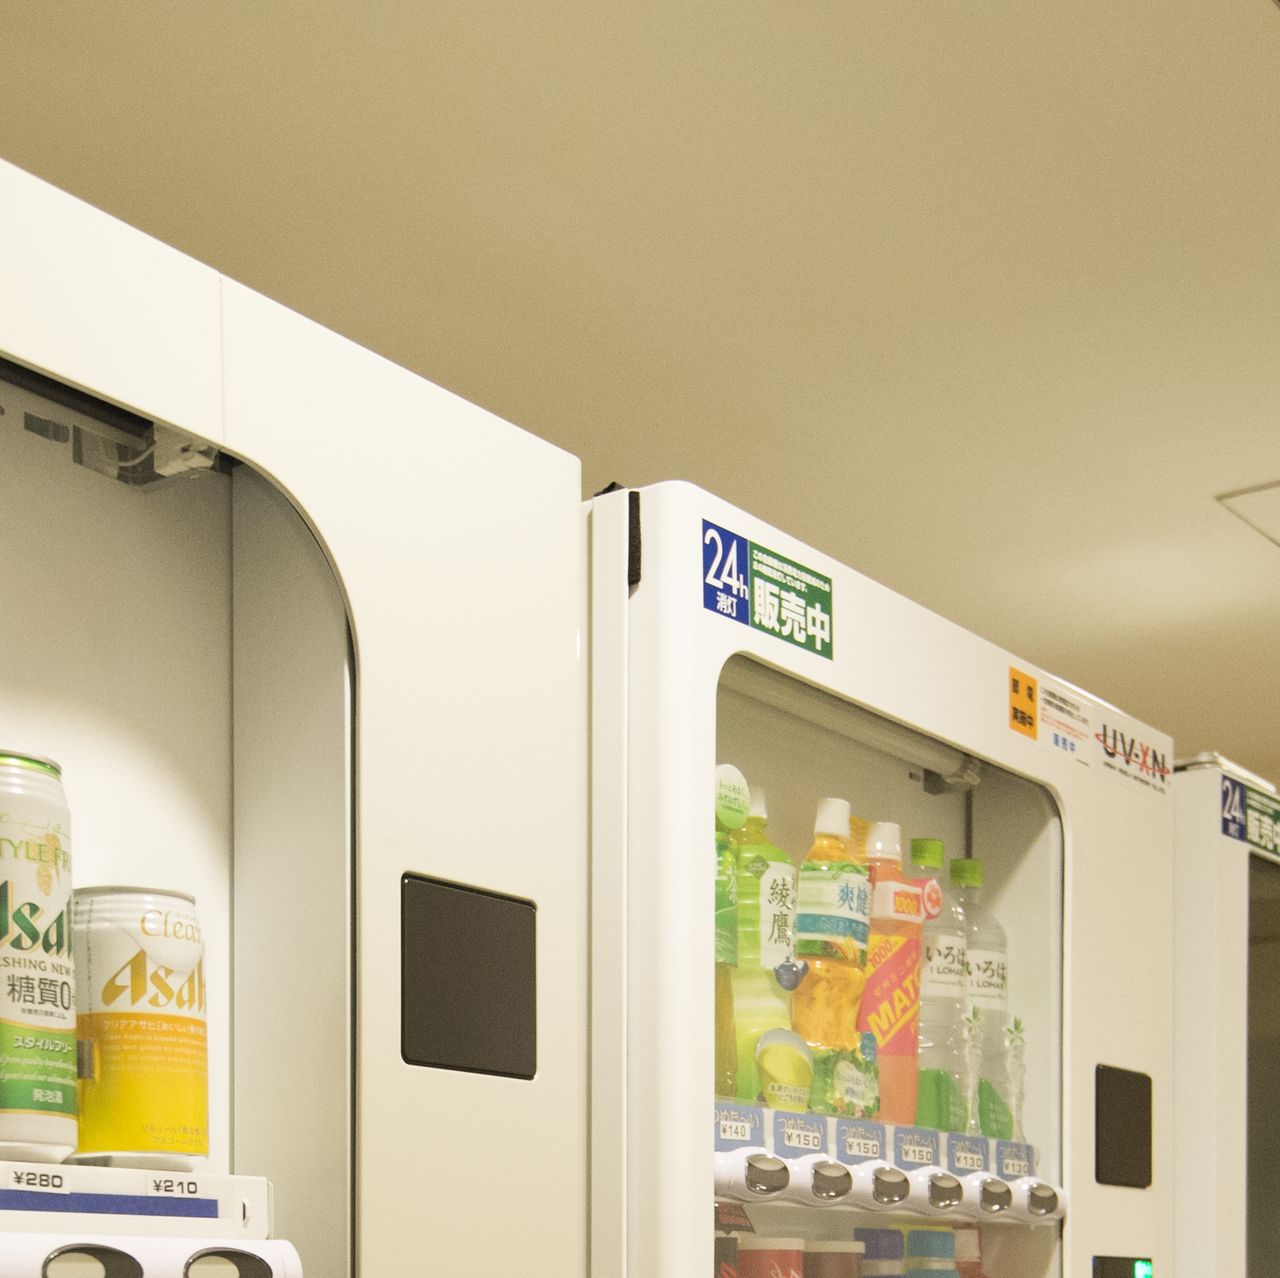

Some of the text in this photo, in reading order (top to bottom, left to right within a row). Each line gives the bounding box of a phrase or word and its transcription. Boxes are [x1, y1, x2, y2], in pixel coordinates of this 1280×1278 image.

[753, 576, 830, 651] 販売中
[54, 849, 71, 873] FR
[768, 876, 792, 947] 綾鷹
[140, 909, 202, 945] Clear
[100, 949, 207, 1014] Asah
[7, 974, 71, 1011] 糖質0
[721, 1124, 747, 1138] ¥140
[785, 1132, 820, 1148] ¥150
[847, 1140, 879, 1155] ¥150
[903, 1148, 933, 1161] ¥150
[955, 1154, 983, 1168] ¥130
[1004, 1162, 1028, 1174] ¥130
[13, 1170, 64, 1189] ¥280
[152, 1178, 198, 1195] ¥210
